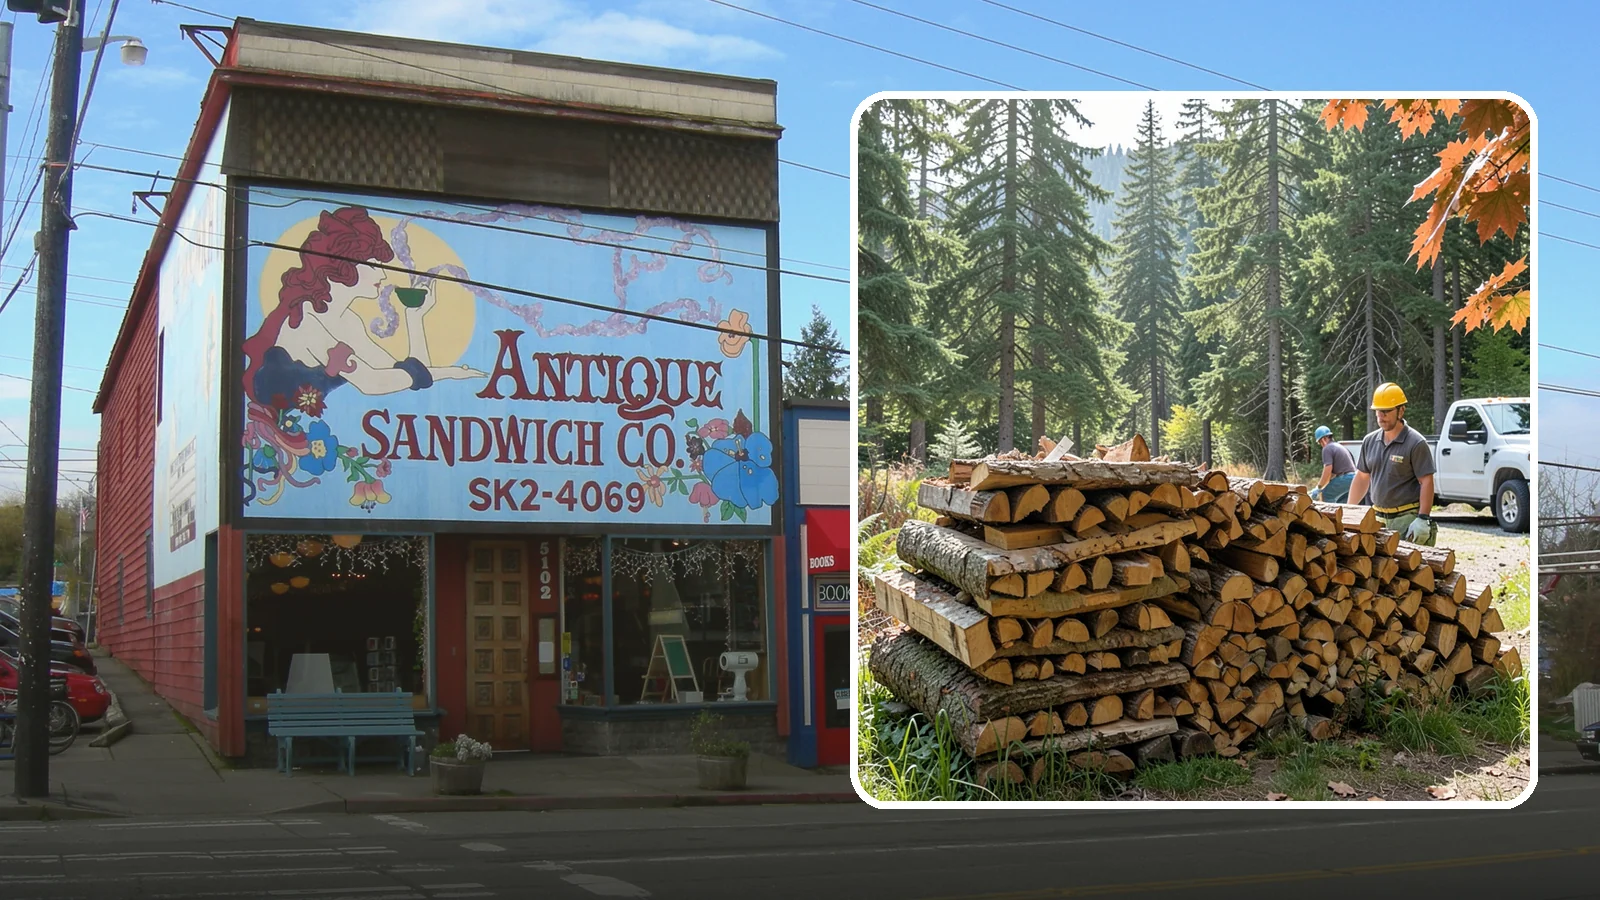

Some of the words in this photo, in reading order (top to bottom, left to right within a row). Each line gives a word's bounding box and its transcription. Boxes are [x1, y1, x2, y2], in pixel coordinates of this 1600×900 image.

[475, 329, 724, 421] ANTIQUE
[361, 408, 604, 467] SANDWICH
[616, 422, 685, 468] CO.
[468, 477, 646, 513] SK2-4069
[540, 541, 551, 600] 5102
[809, 555, 835, 569] BOOKS
